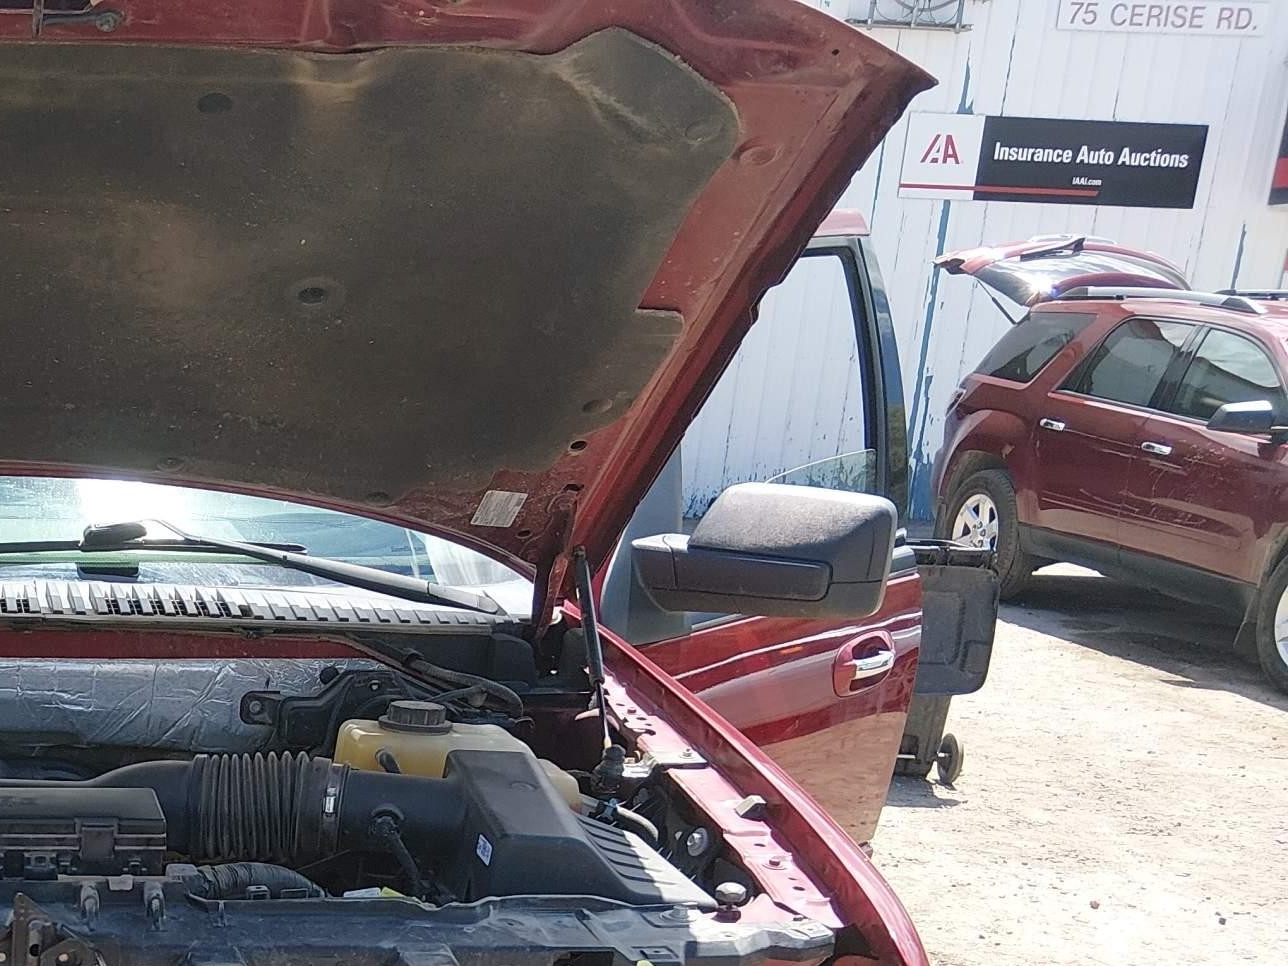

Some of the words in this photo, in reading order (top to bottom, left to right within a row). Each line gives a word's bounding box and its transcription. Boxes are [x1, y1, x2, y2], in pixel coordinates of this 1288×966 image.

[1069, 1, 1099, 26] 75
[1110, 3, 1207, 29] CERISE
[1215, 7, 1258, 31] RD.
[993, 141, 1073, 163] Insurance
[1076, 145, 1115, 166] Auto
[1118, 147, 1190, 168] Auctions
